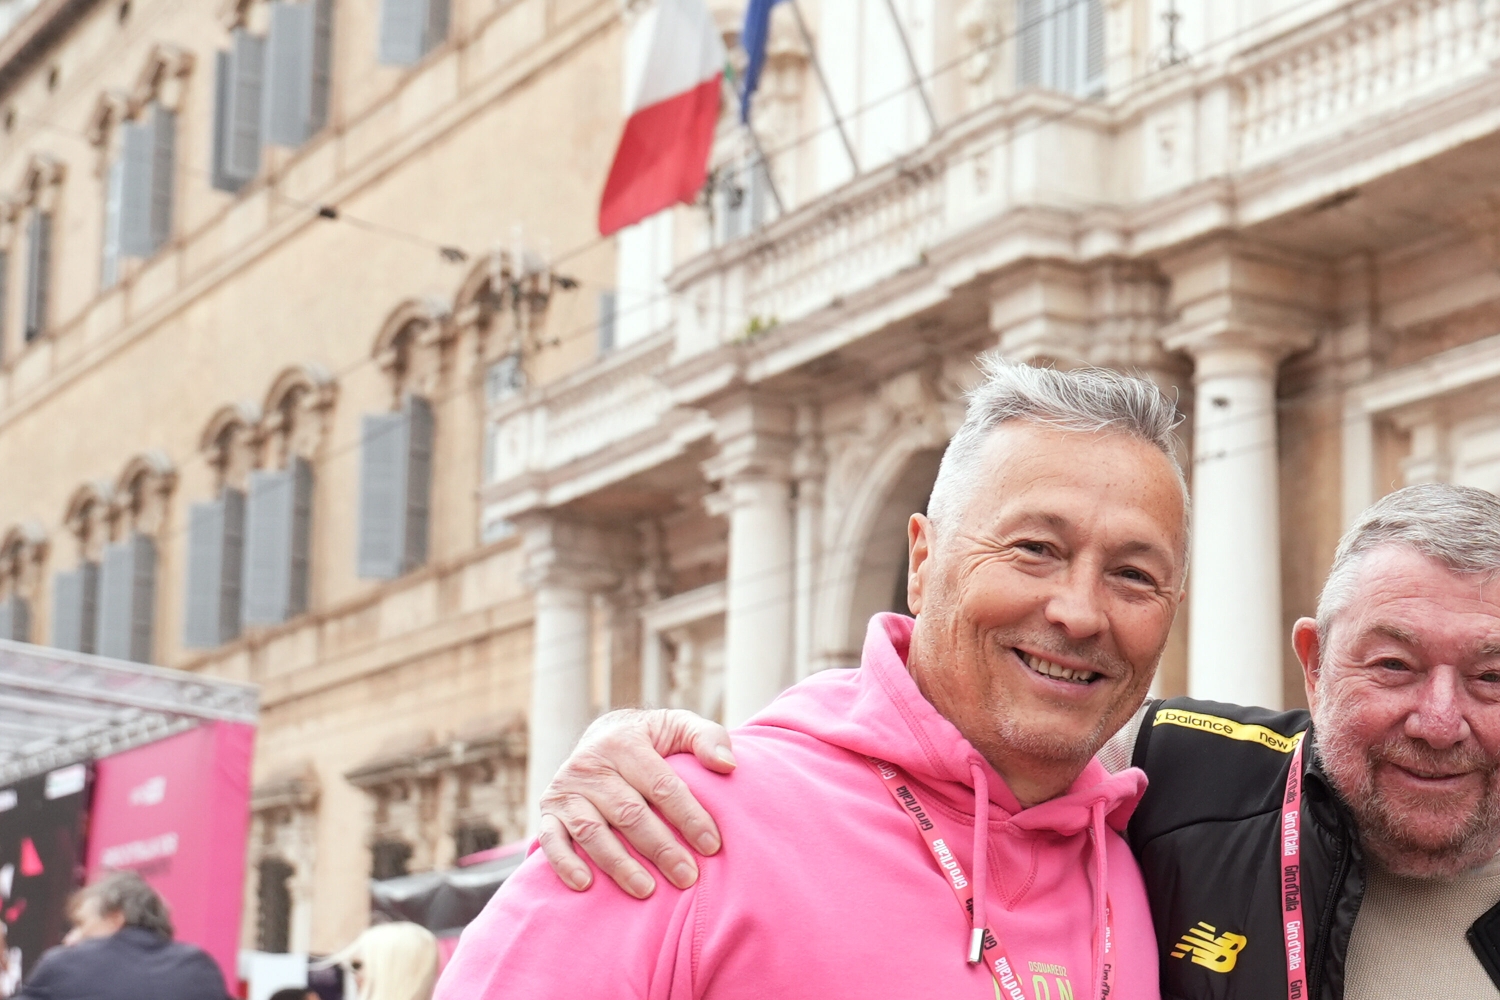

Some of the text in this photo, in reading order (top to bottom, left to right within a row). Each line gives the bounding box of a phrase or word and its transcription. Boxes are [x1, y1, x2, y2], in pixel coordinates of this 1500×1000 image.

[1165, 711, 1234, 734] balance
[1260, 730, 1288, 750] new
[895, 784, 934, 831] Giro d'Italia
[1283, 810, 1299, 857] Giro d'Italia
[931, 838, 969, 891] Giro d'Italia
[1284, 864, 1301, 912] Giro d'Italia
[1286, 919, 1302, 971] Giro d'Italia
[994, 956, 1018, 990] d'Italia
